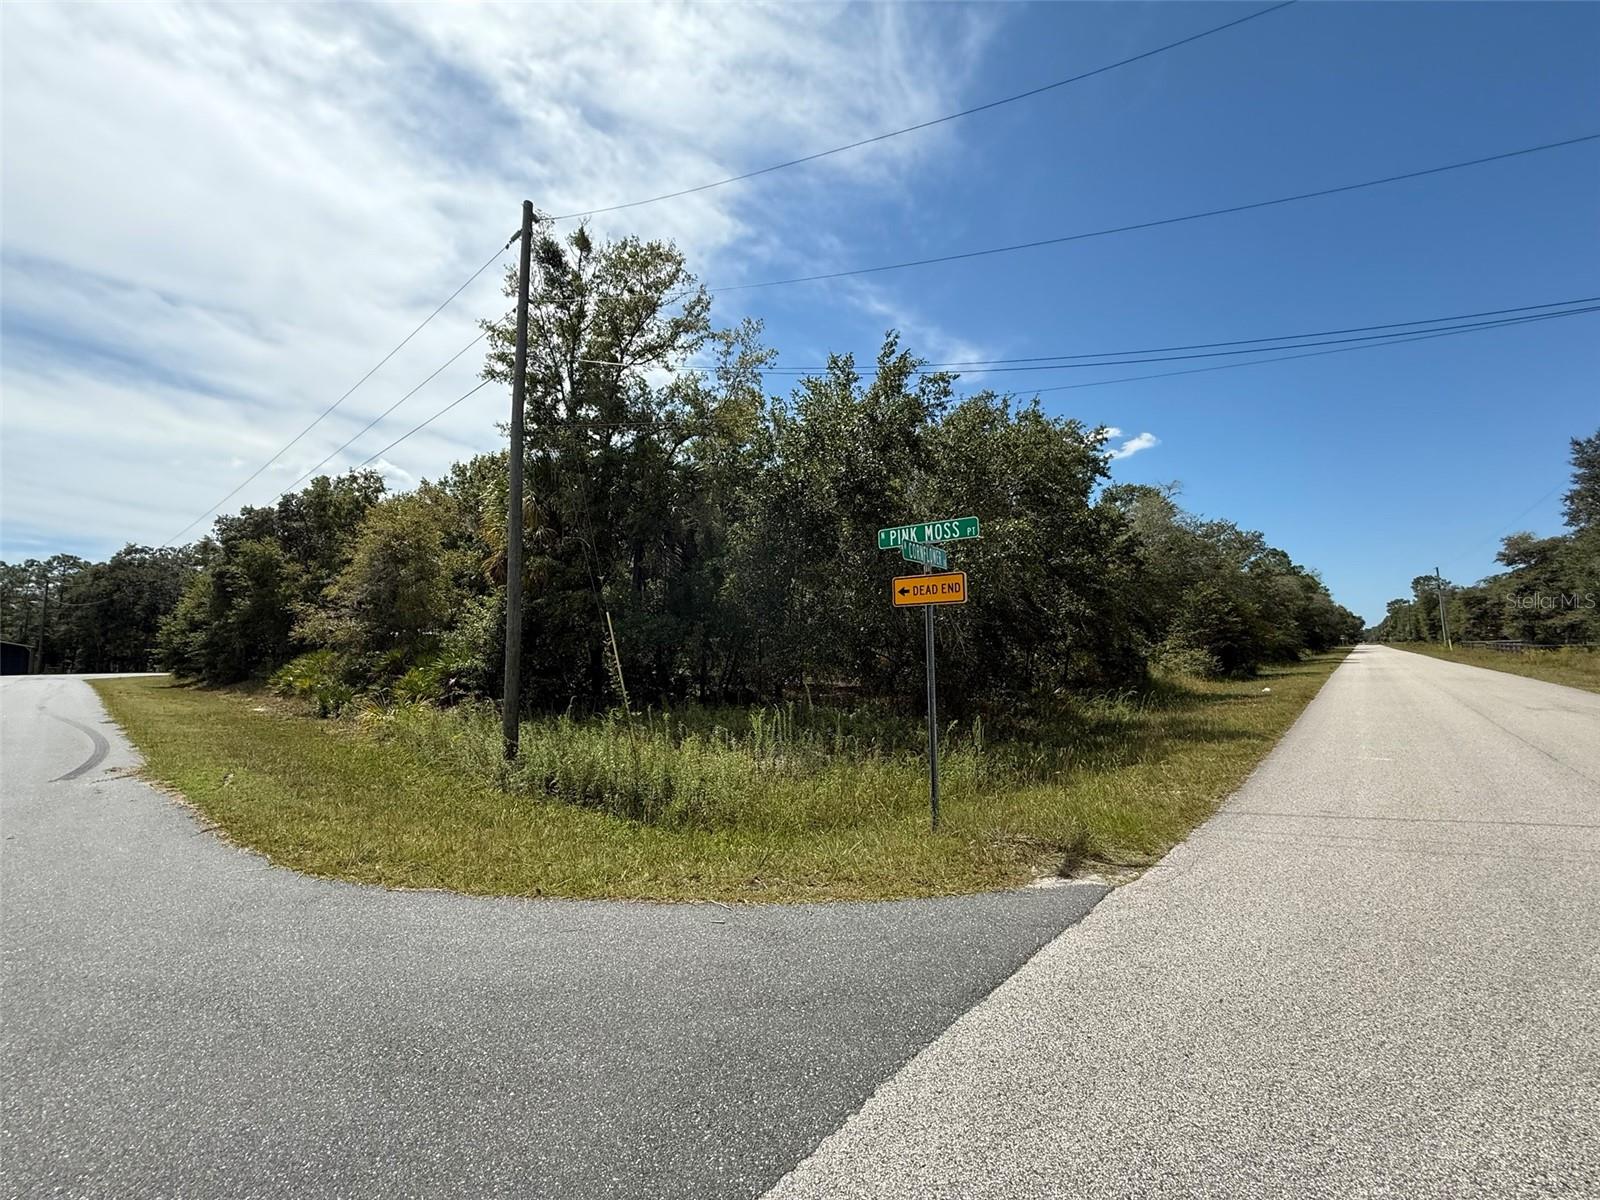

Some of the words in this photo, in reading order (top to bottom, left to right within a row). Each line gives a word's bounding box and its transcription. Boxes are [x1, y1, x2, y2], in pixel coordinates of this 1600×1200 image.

[890, 527, 917, 546] PINK
[925, 521, 960, 541] MOSS
[913, 584, 938, 596] DEAD
[941, 582, 961, 594] END
